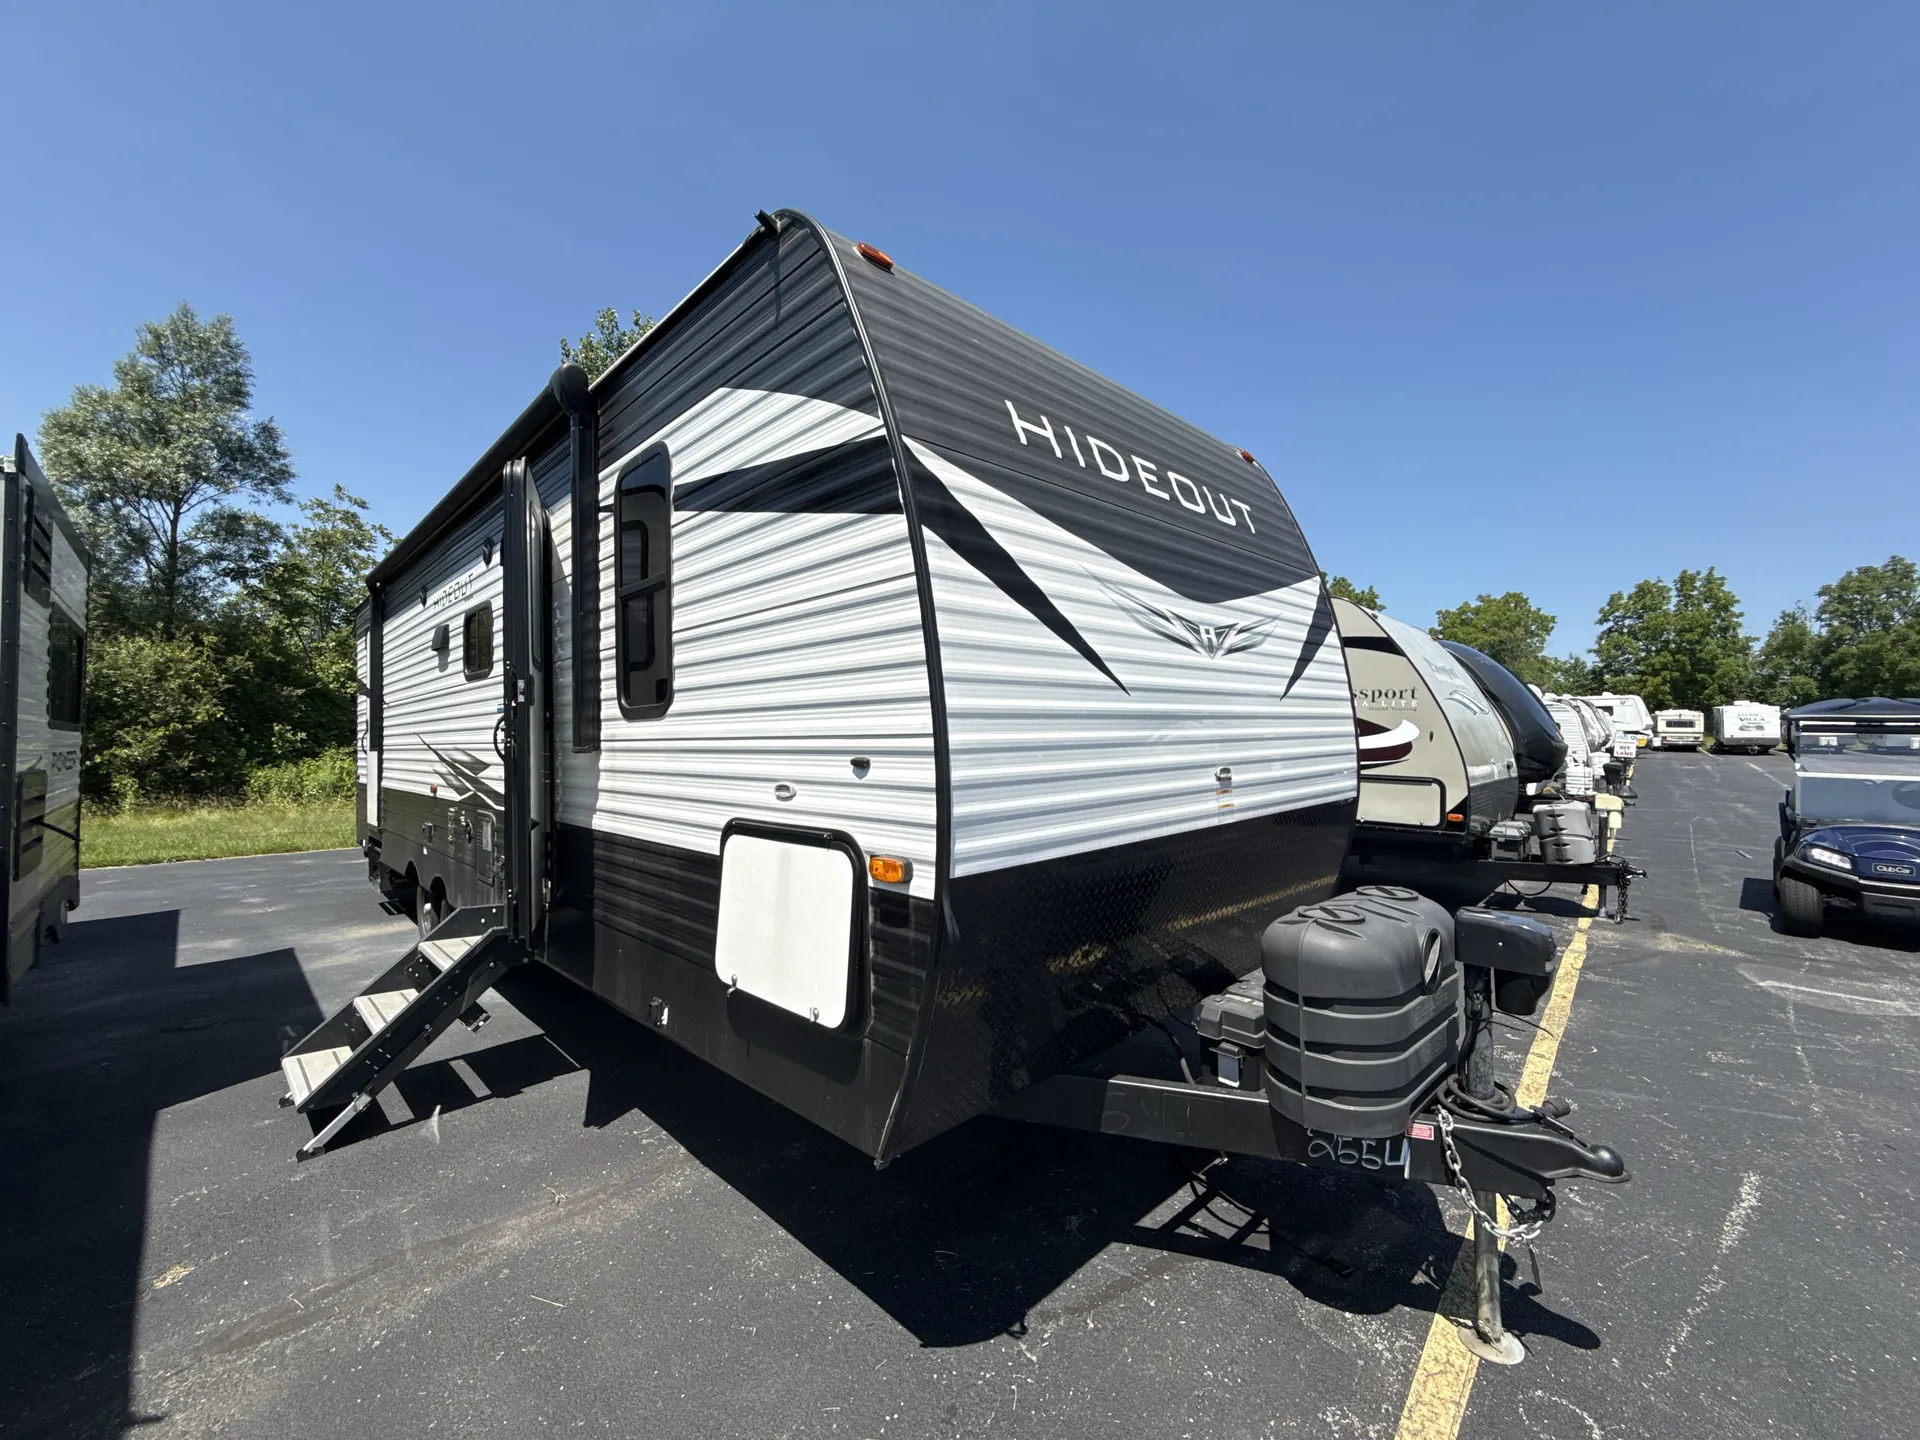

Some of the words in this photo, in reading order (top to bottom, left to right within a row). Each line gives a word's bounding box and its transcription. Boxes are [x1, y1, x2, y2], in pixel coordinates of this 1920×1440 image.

[1004, 399, 1256, 534] HIDEOUT
[433, 573, 474, 610] HIDEOUT
[1307, 1128, 1411, 1180] 2554
